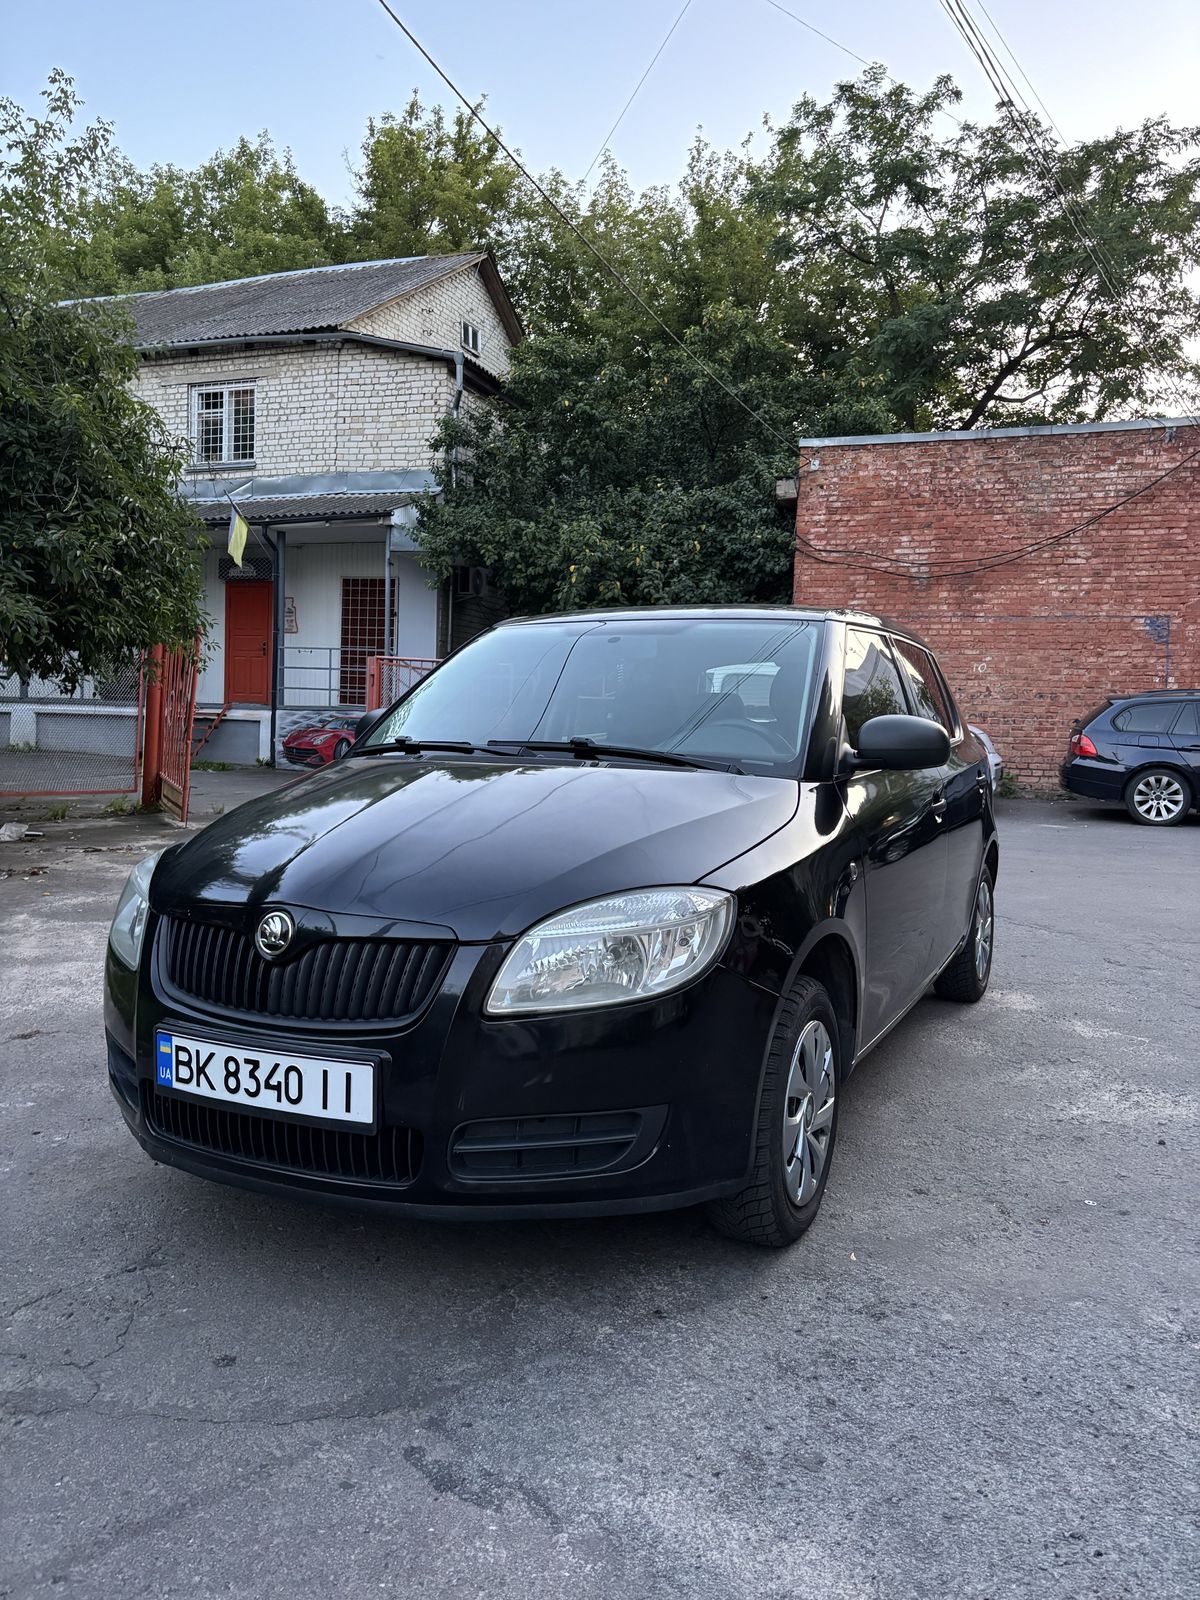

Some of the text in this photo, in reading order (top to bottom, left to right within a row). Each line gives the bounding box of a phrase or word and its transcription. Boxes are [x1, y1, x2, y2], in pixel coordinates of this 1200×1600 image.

[159, 1066, 172, 1080] UA
[174, 1044, 352, 1114] BK 8340 II
